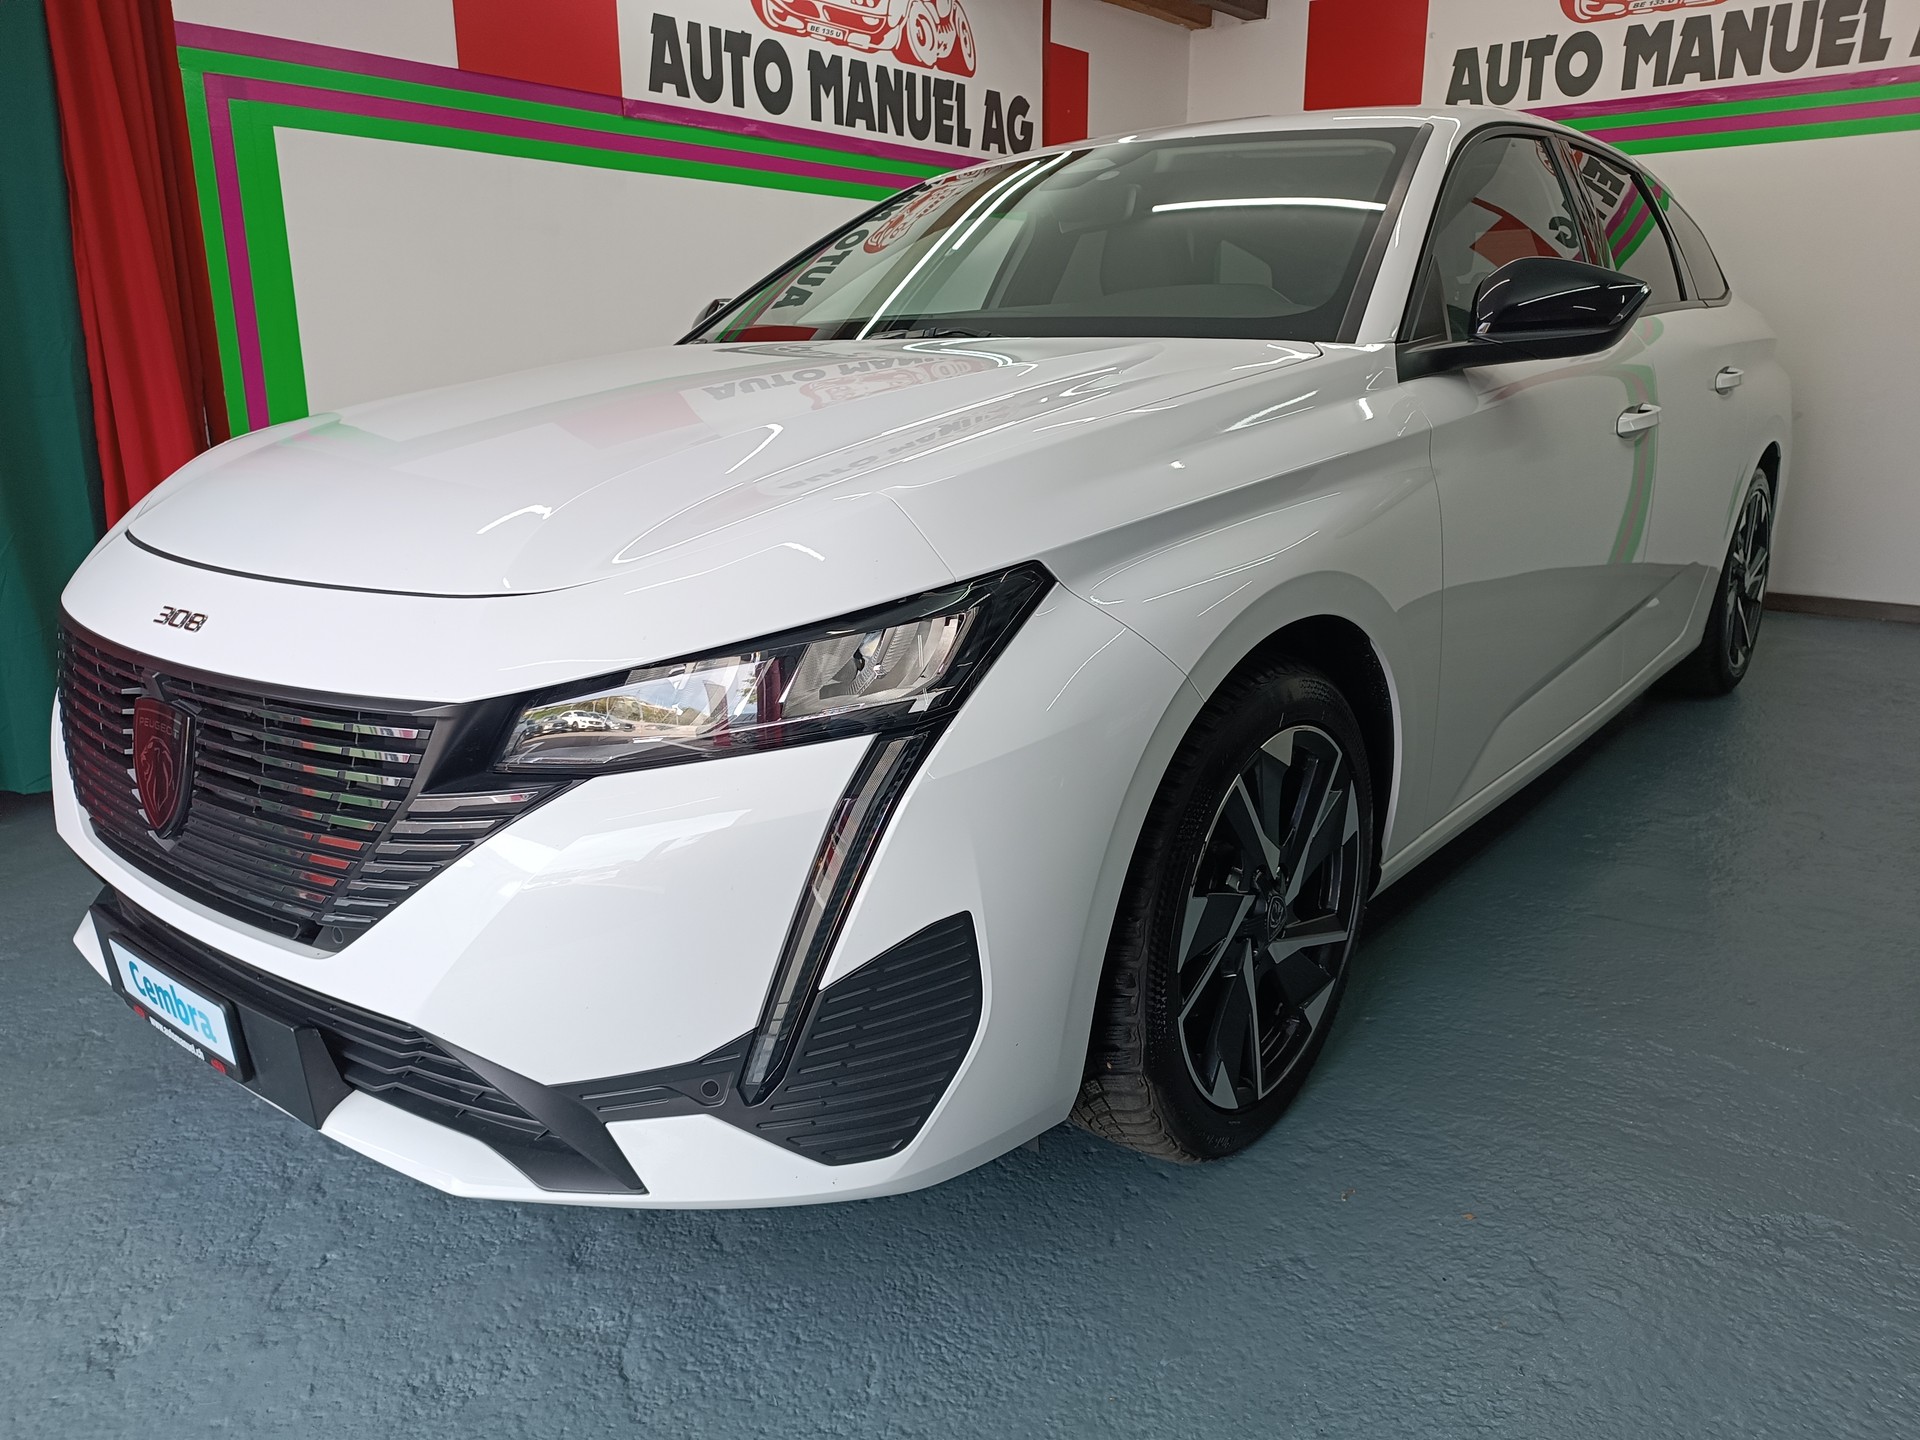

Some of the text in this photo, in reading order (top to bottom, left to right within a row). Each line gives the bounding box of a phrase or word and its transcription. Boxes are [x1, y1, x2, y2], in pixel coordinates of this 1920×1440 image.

[648, 13, 1034, 155] AUTO MANUEL AG
[1445, 0, 1893, 106] AUTO MANUEL
[153, 605, 208, 632] 308
[139, 716, 180, 739] PEUGEOT
[128, 960, 218, 1044] Cembra
